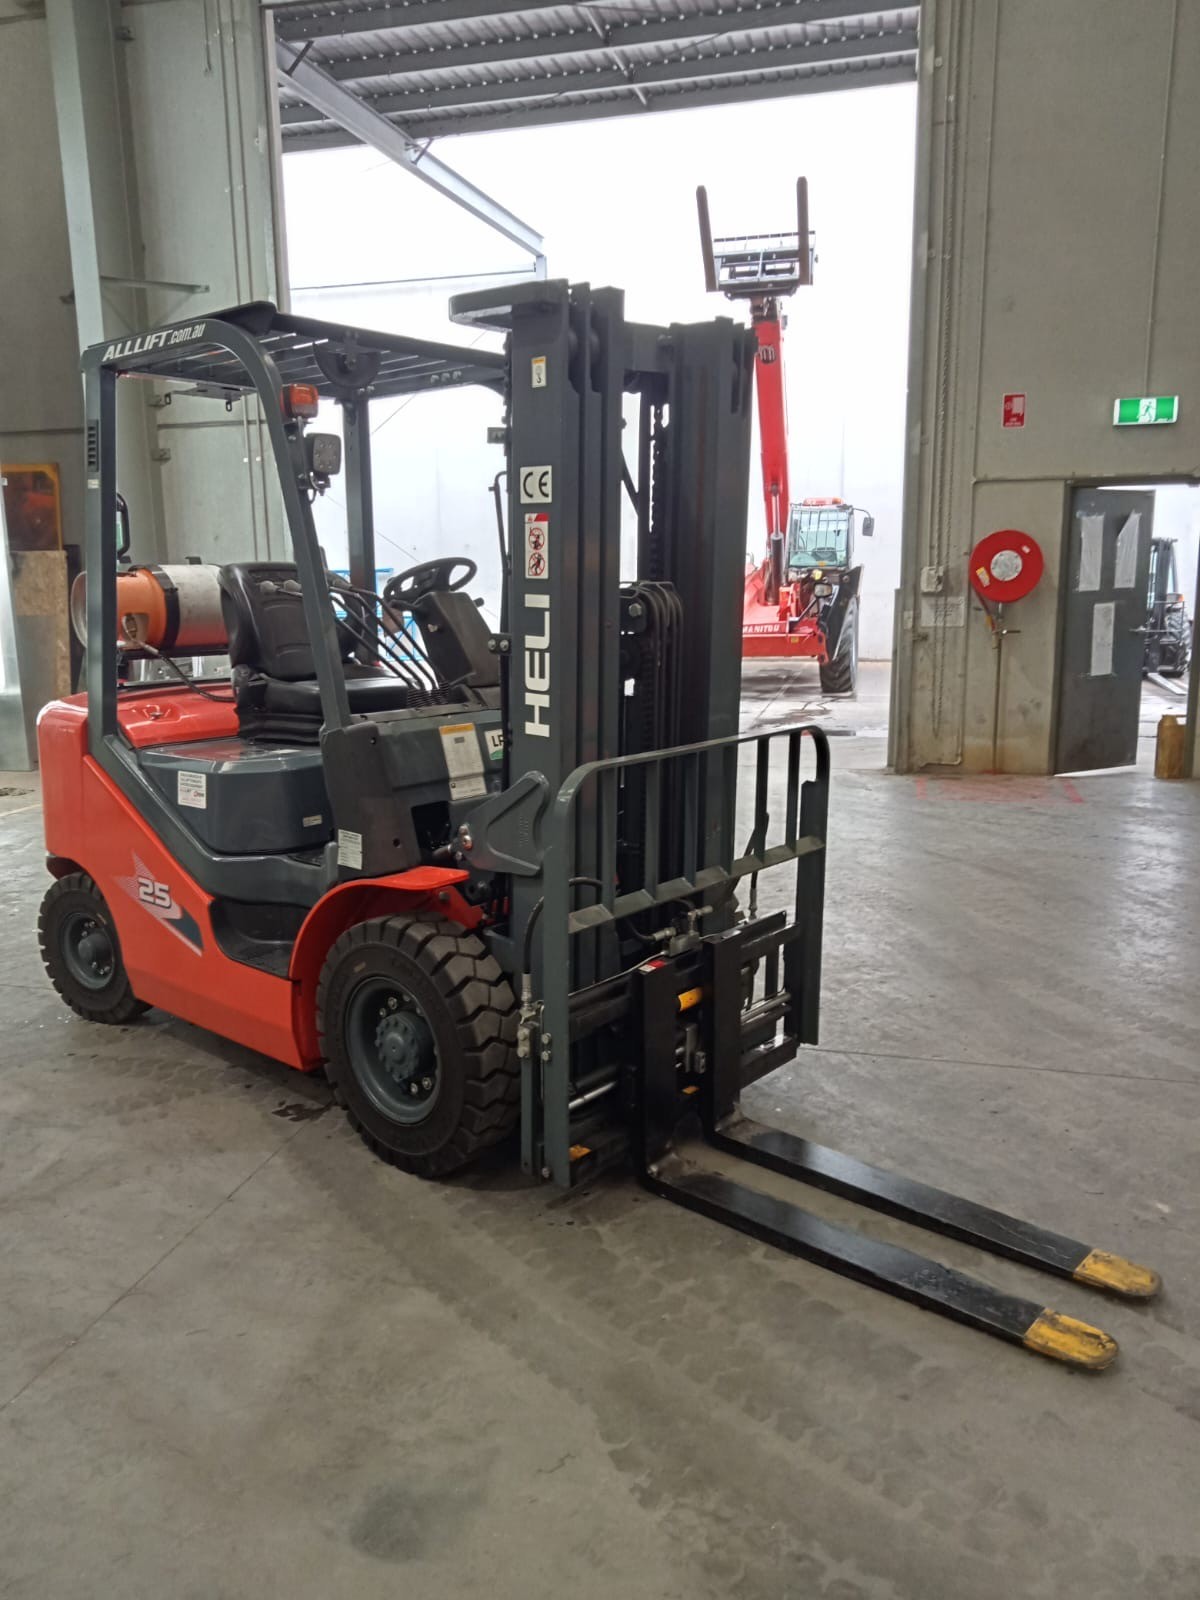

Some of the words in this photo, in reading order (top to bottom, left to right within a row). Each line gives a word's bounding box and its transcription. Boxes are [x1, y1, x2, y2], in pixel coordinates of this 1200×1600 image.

[523, 471, 549, 498] CE
[524, 593, 550, 737] HELI
[138, 876, 172, 909] 25
